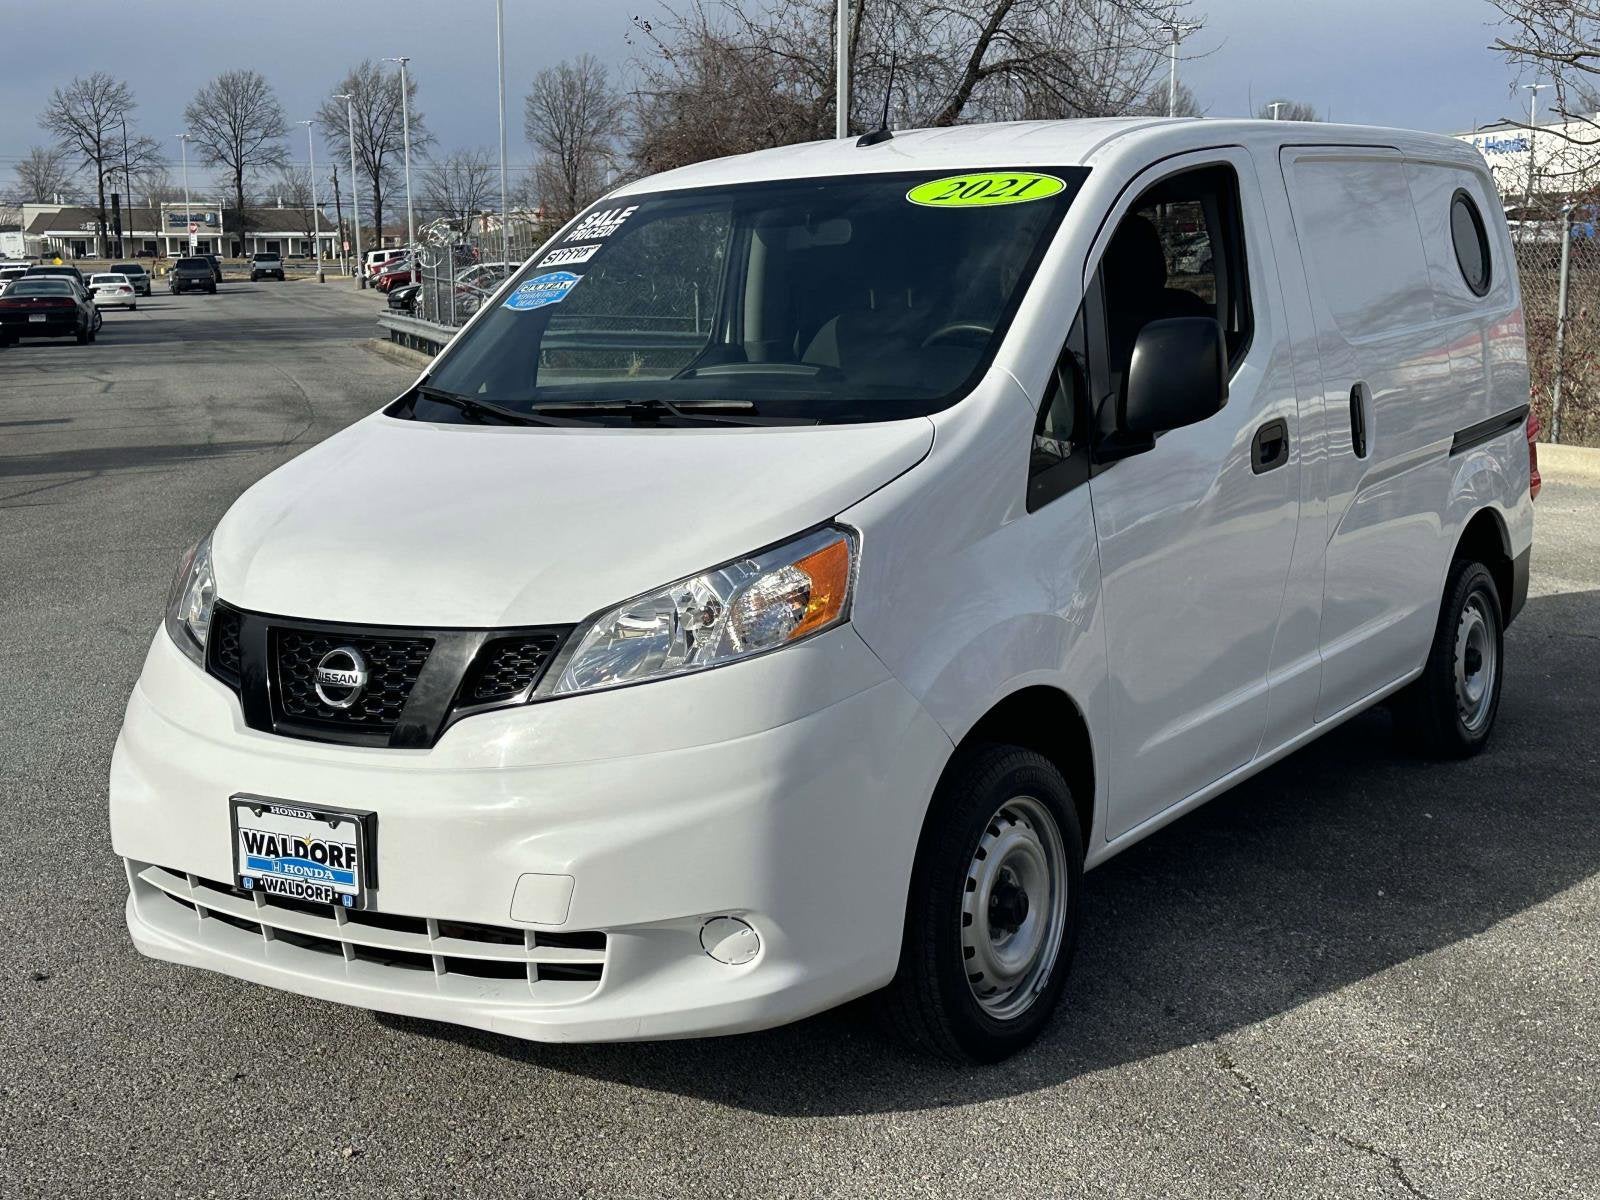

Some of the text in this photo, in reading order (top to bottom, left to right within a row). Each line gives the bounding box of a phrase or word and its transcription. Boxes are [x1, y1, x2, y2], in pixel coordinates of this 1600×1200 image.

[929, 178, 1043, 201] 2021
[576, 205, 640, 231] SALE
[270, 806, 316, 820] HONDA
[240, 829, 358, 870] WALDORF
[284, 863, 335, 880] HONDA
[264, 876, 333, 903] WALDORF
